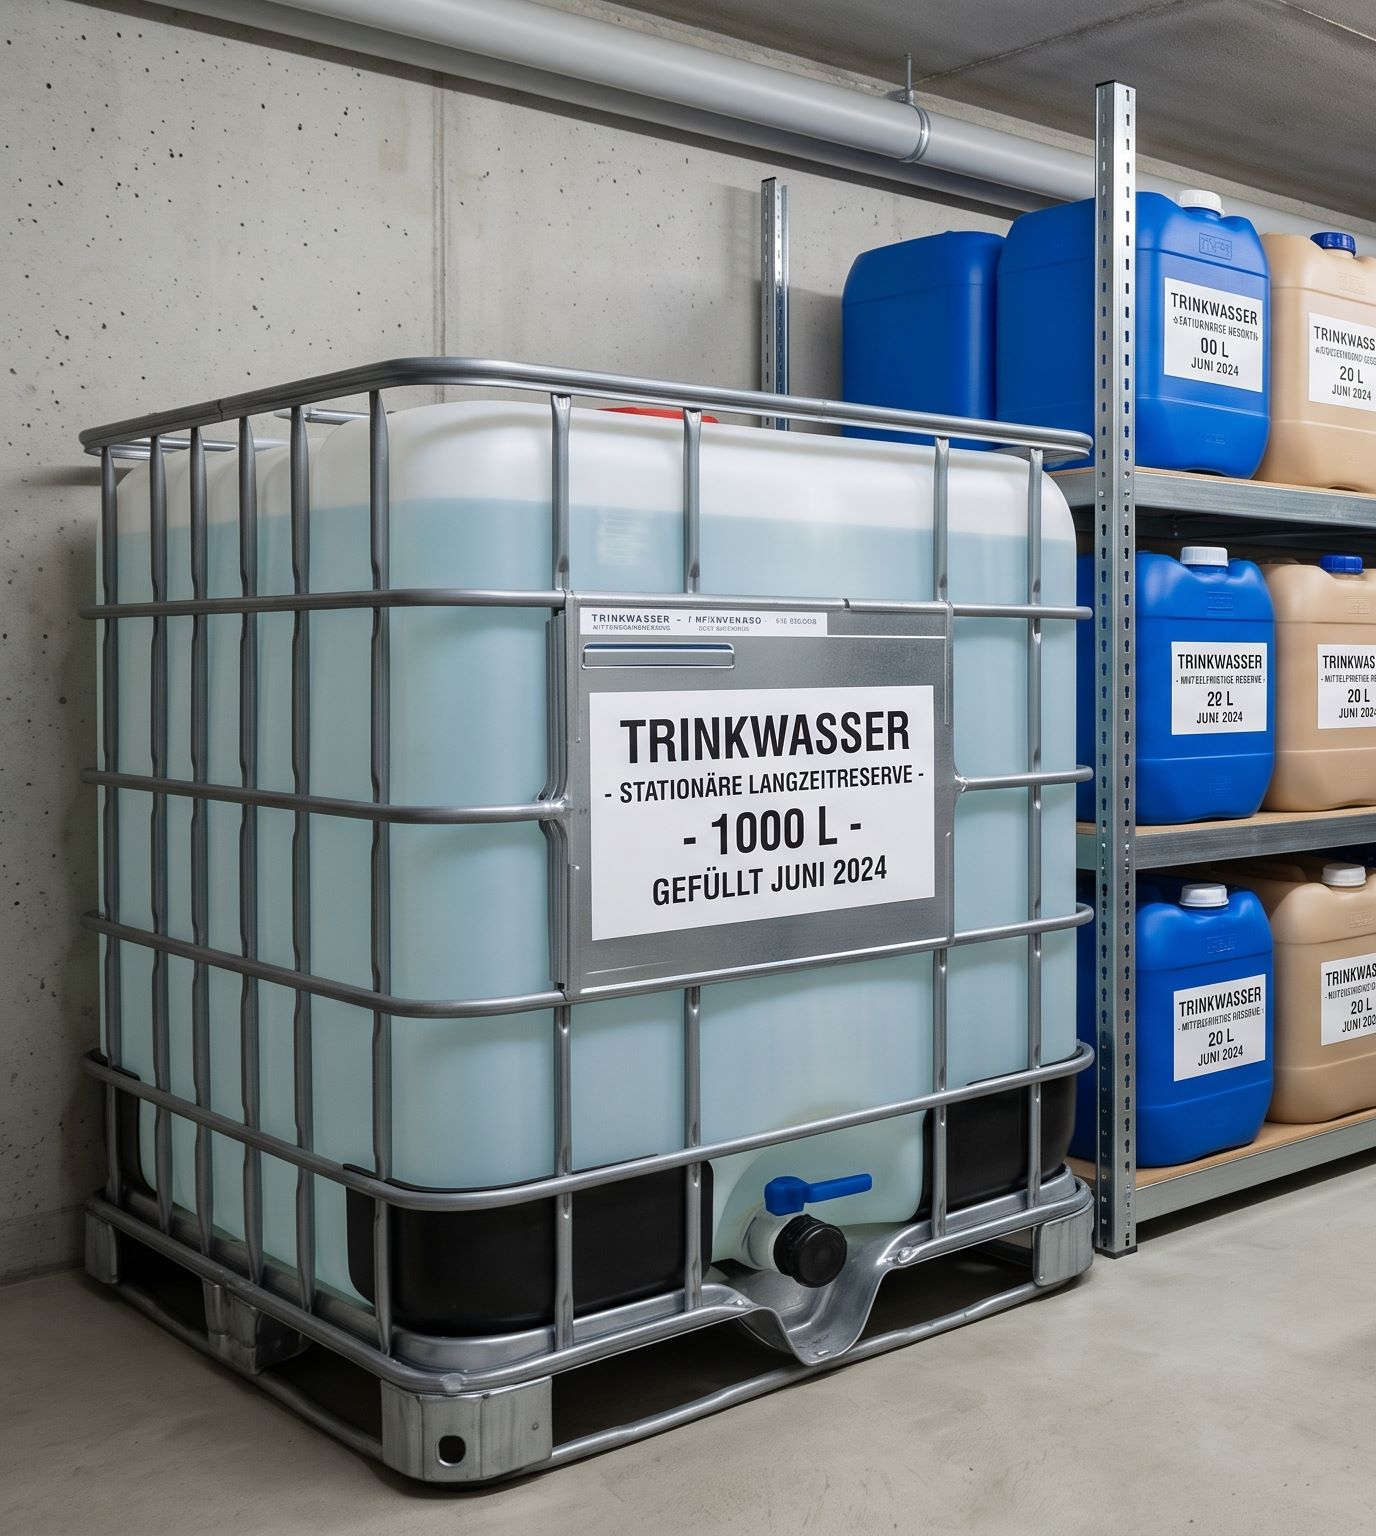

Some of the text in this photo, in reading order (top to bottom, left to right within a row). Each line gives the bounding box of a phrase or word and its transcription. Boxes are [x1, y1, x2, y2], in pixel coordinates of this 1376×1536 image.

[1171, 292, 1258, 325] TRINKWASSER
[1222, 341, 1228, 358] L
[1191, 357, 1239, 376] JUNI 2024
[1340, 366, 1363, 384] 20 L
[1332, 384, 1371, 400] JUNI 2024
[592, 614, 670, 623] TRINKWASSER
[1178, 654, 1262, 669] TRINKWASSER
[1227, 691, 1233, 706] L
[1348, 689, 1370, 703] 20 L
[1222, 711, 1242, 722] 2024
[1339, 708, 1358, 718] JUNI
[620, 710, 910, 764] TRINKWASSER
[620, 773, 742, 803] STATIONÄRE
[749, 765, 913, 795] LANGZEITRESERVE
[711, 807, 805, 855] 1000
[819, 806, 837, 846] L
[653, 855, 887, 906] GEFÜLLT JUNI 2024
[1179, 986, 1261, 1017] TRINKWASSER
[1351, 998, 1372, 1015] 20 L
[1342, 1018, 1360, 1032] JUNI
[1208, 1028, 1234, 1047] 20 L
[1198, 1045, 1243, 1066] JUNI 2024
